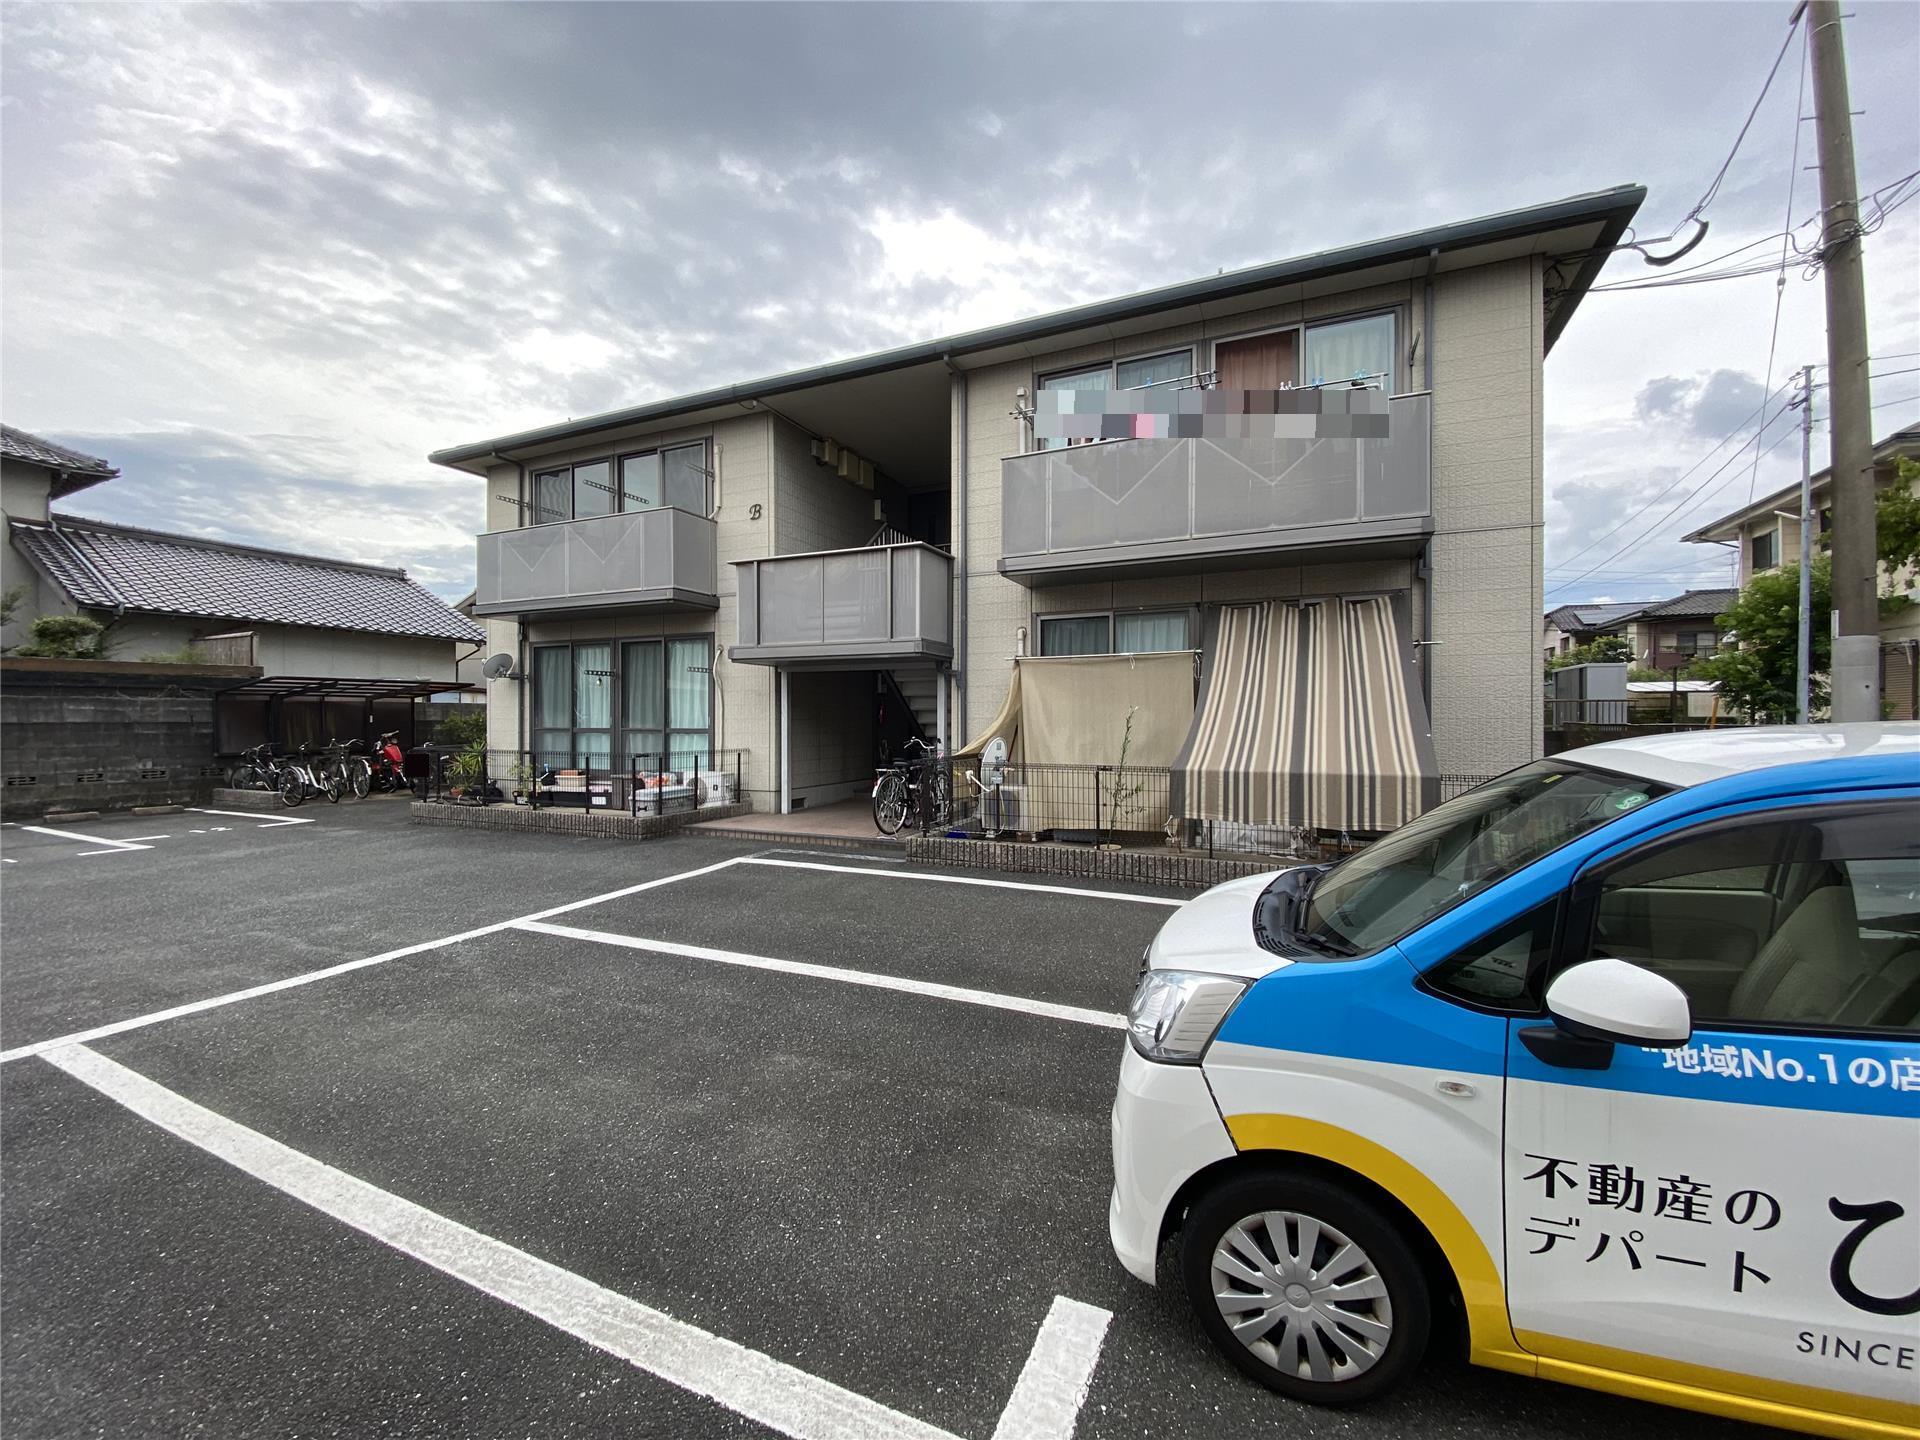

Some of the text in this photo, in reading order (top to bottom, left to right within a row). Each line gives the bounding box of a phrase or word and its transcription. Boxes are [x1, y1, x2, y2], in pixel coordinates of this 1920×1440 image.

[749, 503, 762, 520] B
[1522, 1153, 1782, 1231] 不動産の
[1525, 1216, 1772, 1293] デパート
[1796, 1331, 1915, 1370] SINCE
